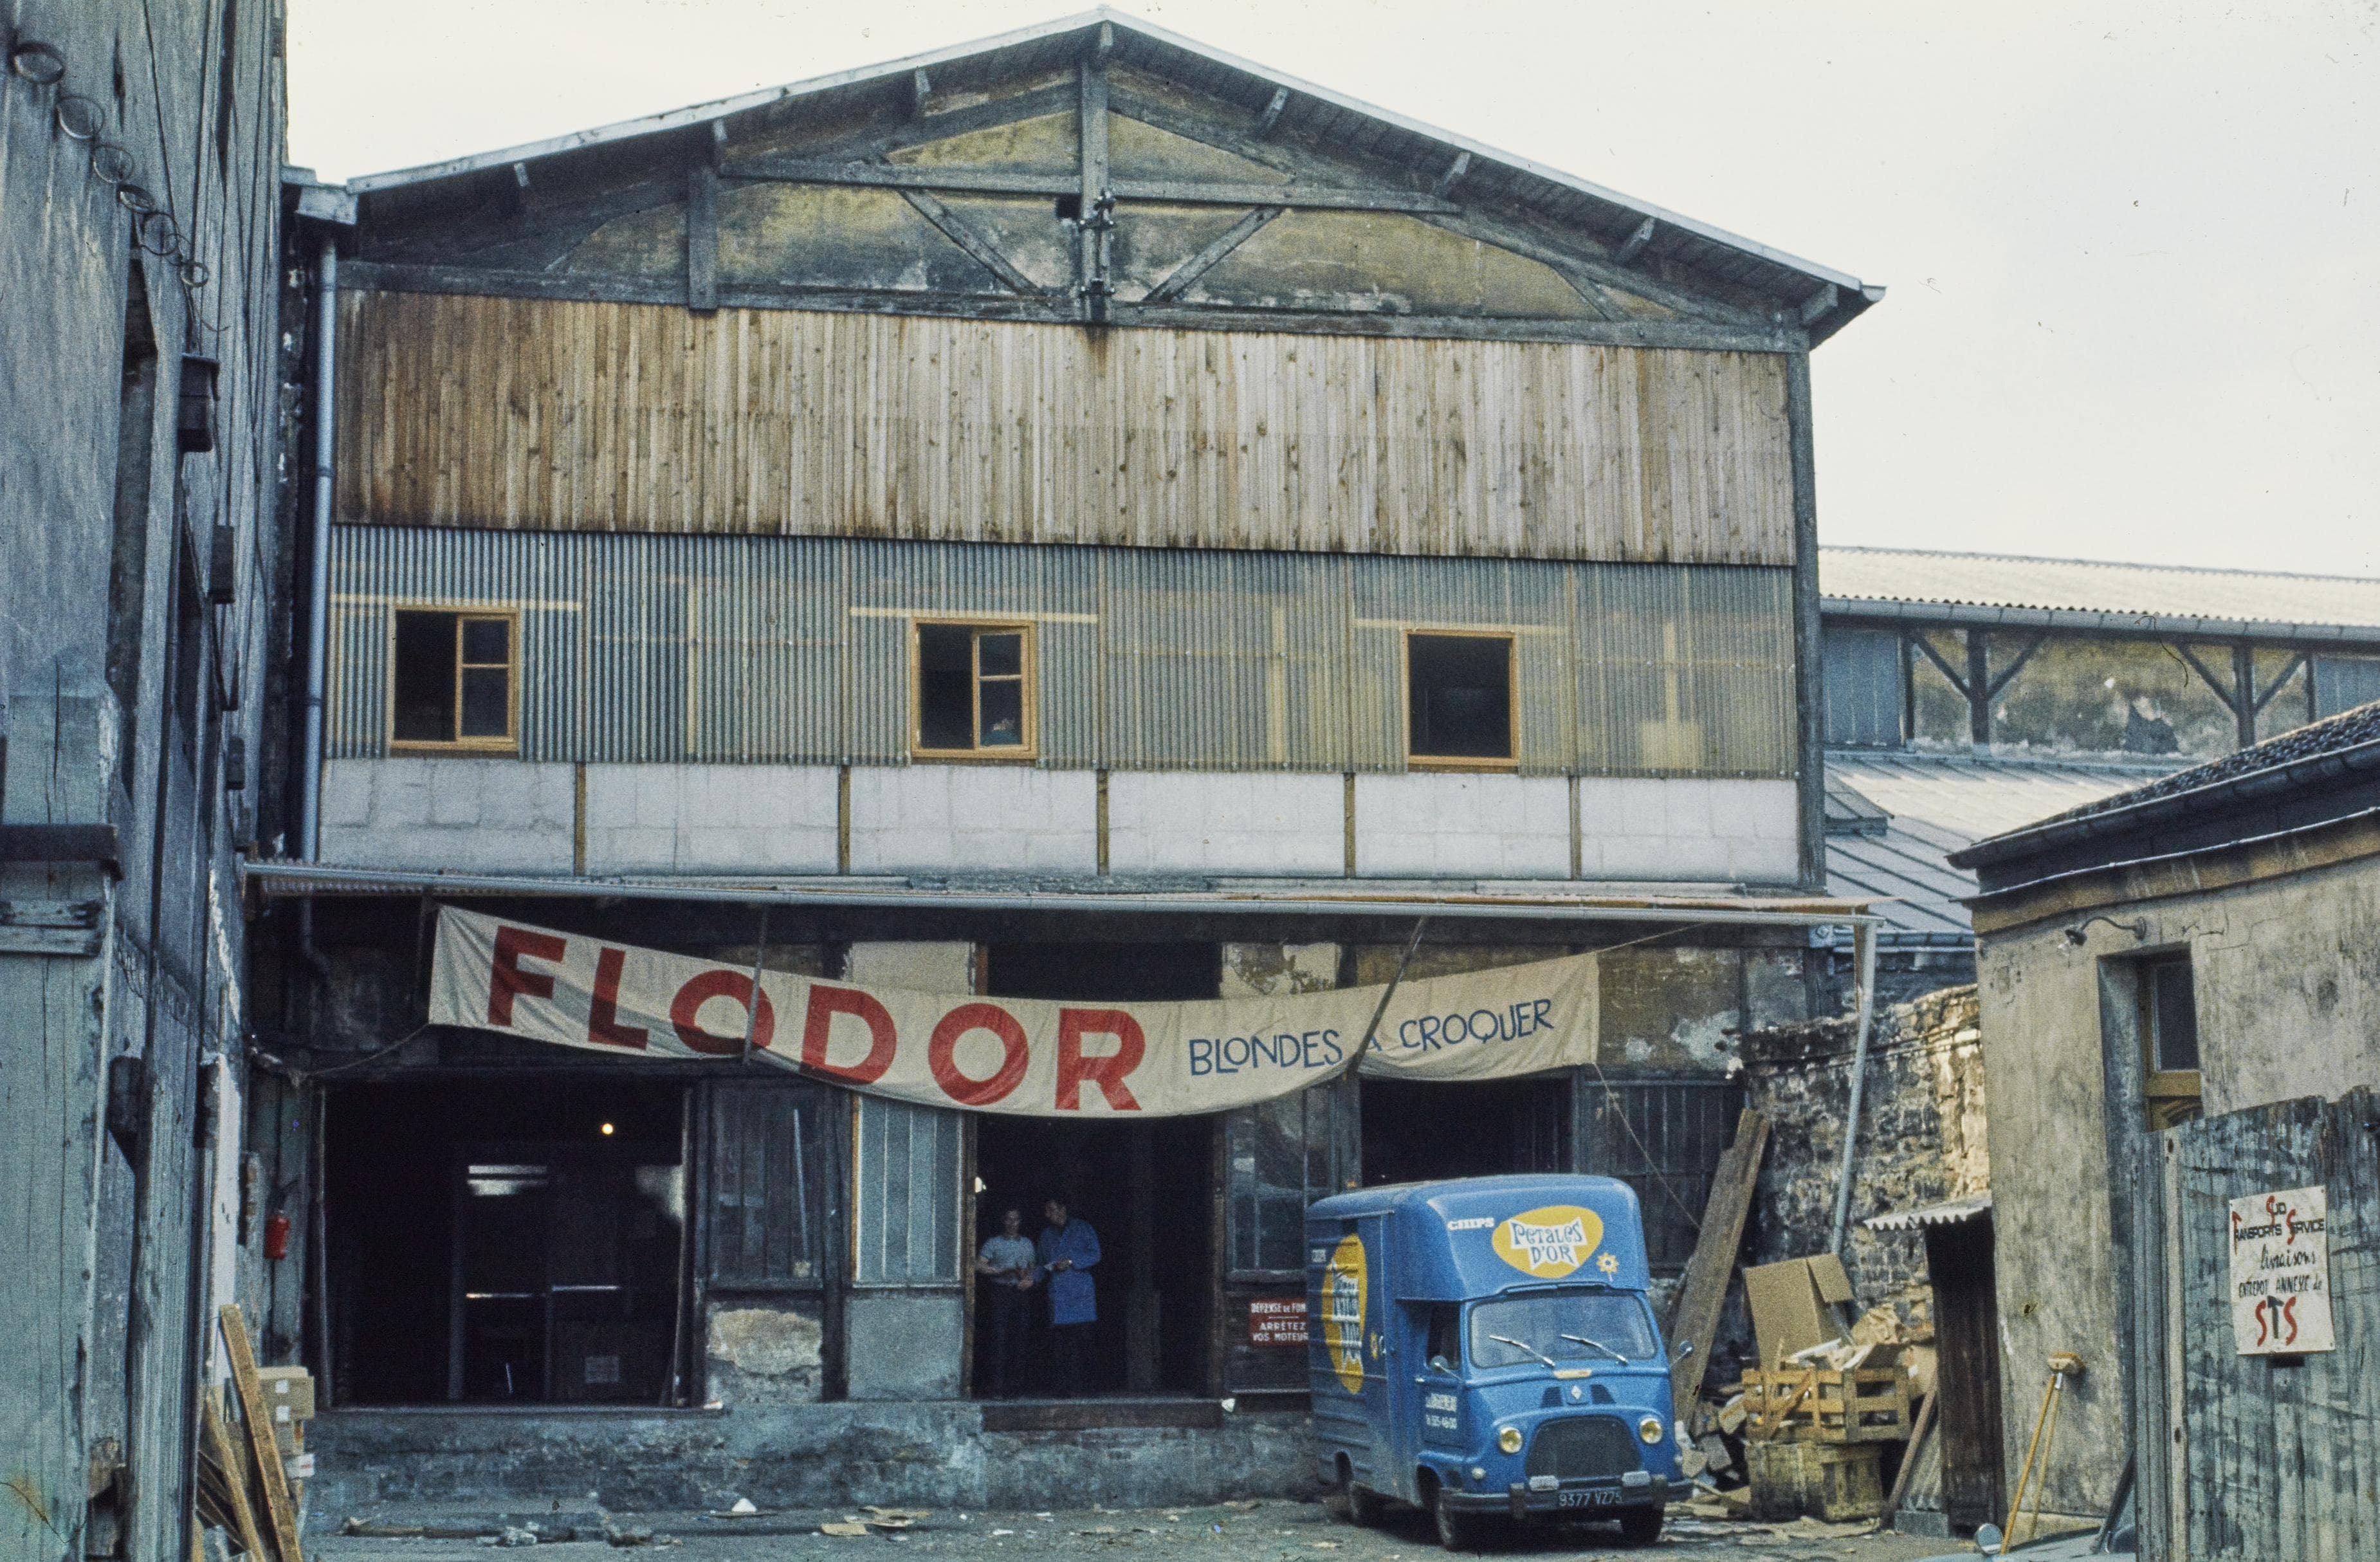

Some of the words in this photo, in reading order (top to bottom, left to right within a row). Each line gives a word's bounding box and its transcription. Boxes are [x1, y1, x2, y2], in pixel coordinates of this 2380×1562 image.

[487, 924, 1145, 1111] FLODOR
[1189, 1029, 1343, 1076] BLONDES
[1398, 998, 1555, 1052] CROQUER
[2255, 1296, 2298, 1346] STS
[1559, 1493, 1590, 1507] 9377
